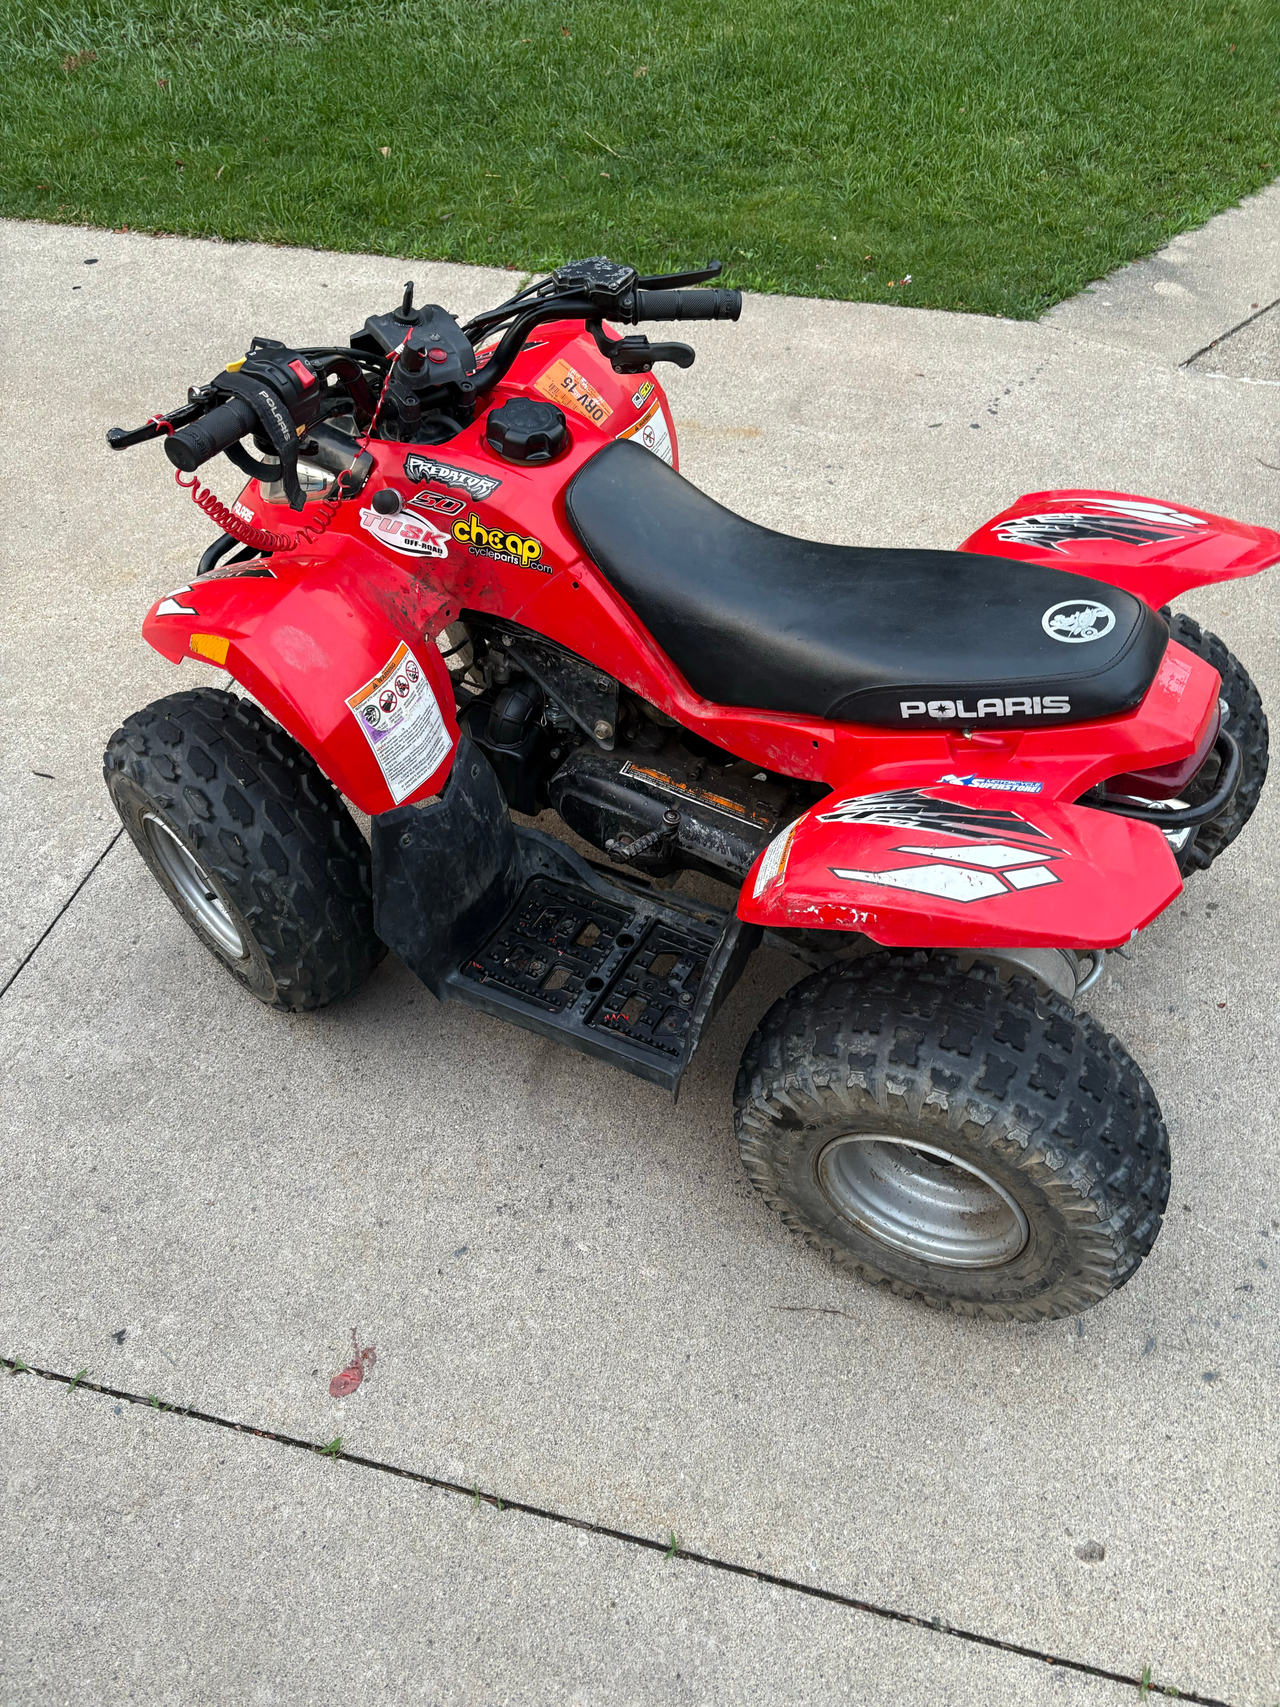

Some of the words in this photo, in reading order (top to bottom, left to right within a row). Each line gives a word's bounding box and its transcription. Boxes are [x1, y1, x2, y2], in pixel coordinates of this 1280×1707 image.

[560, 376, 575, 394] 15
[259, 390, 291, 441] POLARIS
[577, 393, 604, 421] ORV
[405, 455, 501, 500] PREDATOR
[416, 492, 463, 513] 50
[363, 510, 446, 547] TUSK
[453, 513, 541, 566] cheap
[404, 538, 444, 555] OFF-ROAD
[900, 696, 1071, 719] POLARIS
